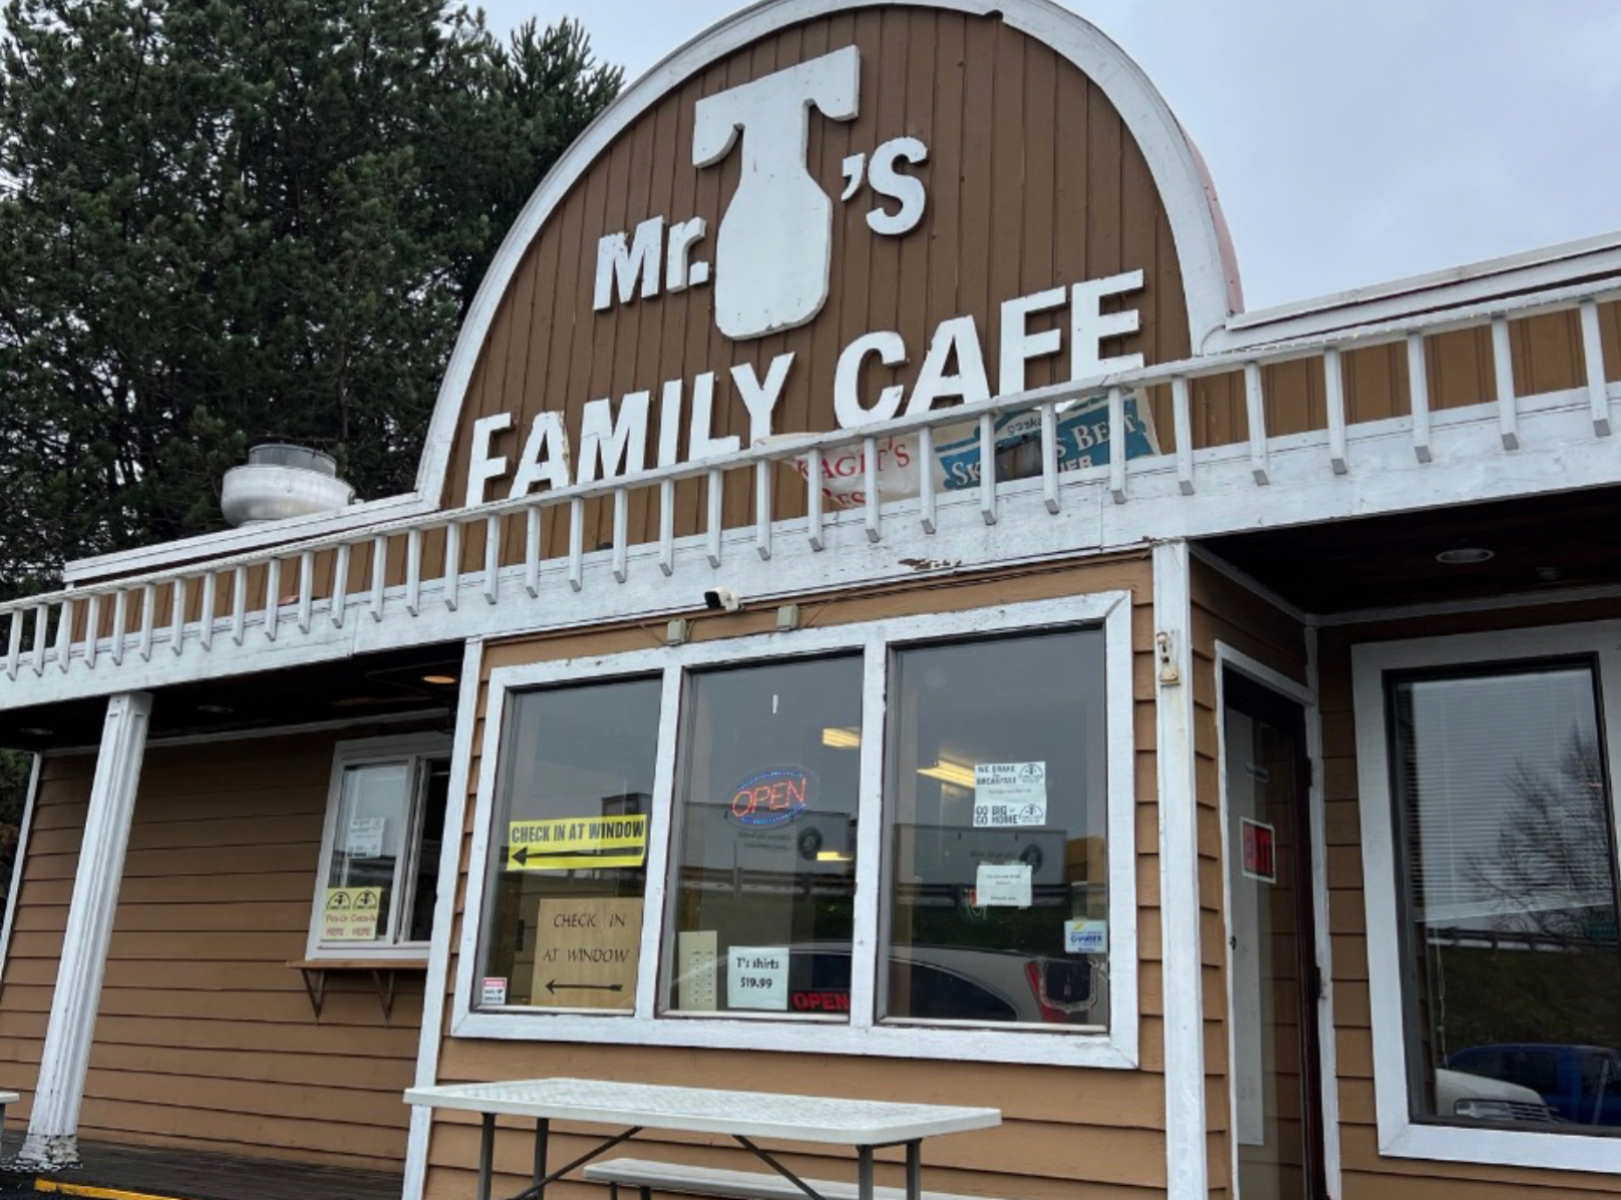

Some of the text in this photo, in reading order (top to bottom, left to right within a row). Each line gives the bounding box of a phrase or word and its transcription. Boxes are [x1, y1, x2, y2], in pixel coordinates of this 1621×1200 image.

[593, 215, 710, 310] Mr.
[466, 269, 1144, 508] FAMILY CAFE
[732, 777, 806, 817] OPEN
[511, 820, 644, 844] CHECK IN AT WINDOW
[553, 913, 626, 928] CHECK IN
[543, 949, 630, 963] AT WINDOW
[736, 957, 780, 970] T's shirts
[740, 977, 773, 989] $19.99
[791, 992, 850, 1010] OPEN
